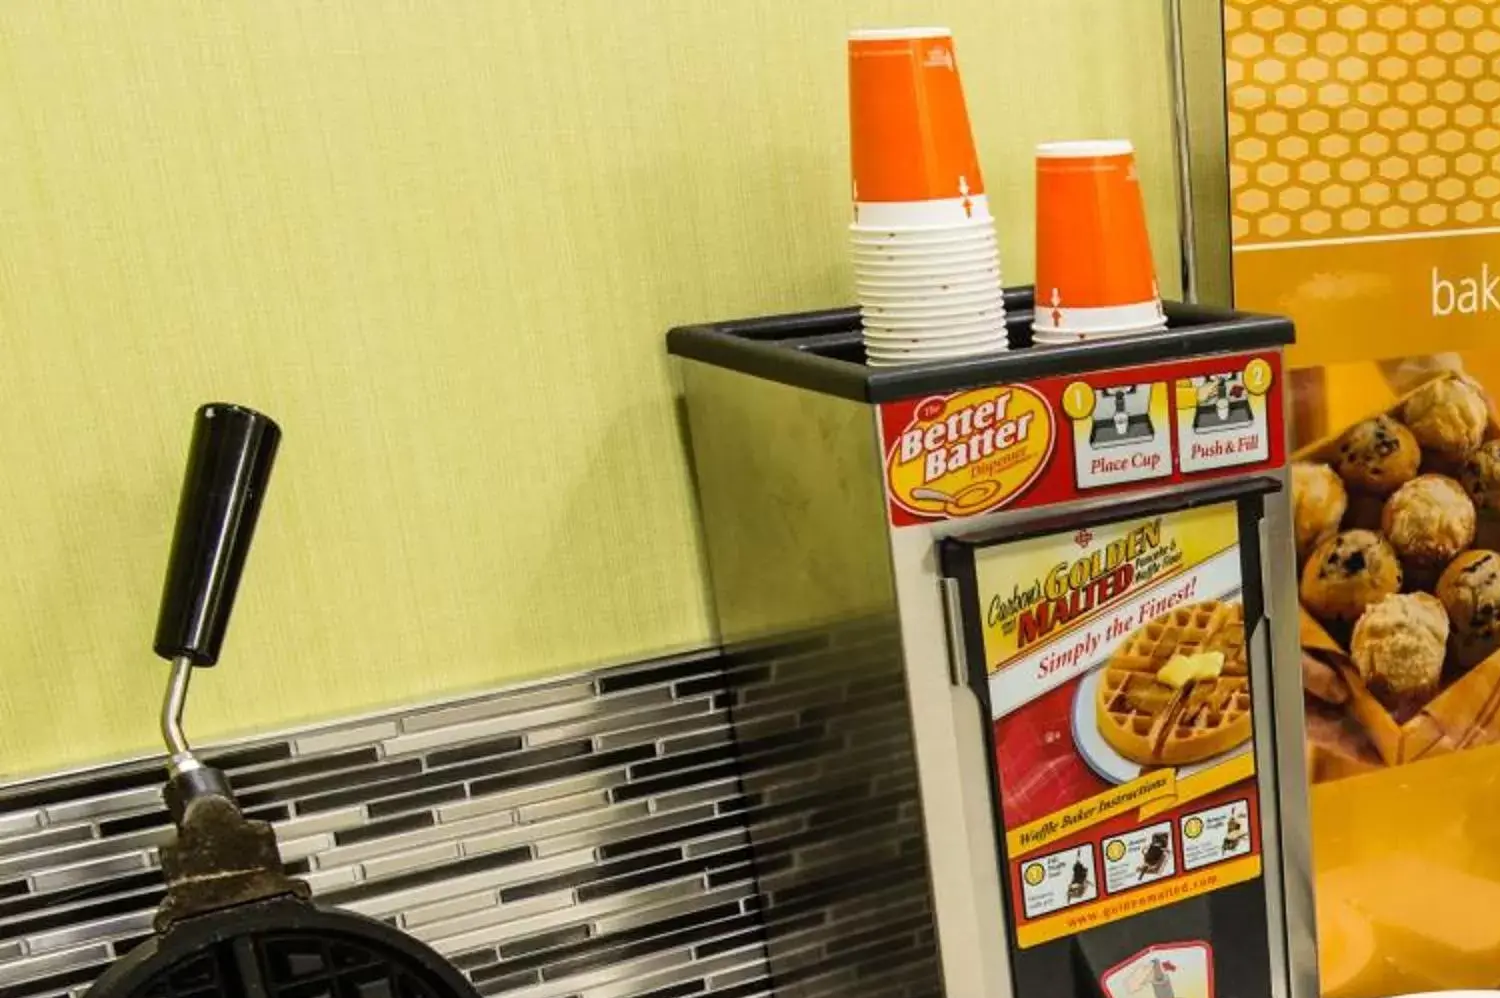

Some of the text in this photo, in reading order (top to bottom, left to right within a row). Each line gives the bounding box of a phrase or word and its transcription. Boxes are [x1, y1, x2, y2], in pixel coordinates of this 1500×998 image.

[899, 391, 1012, 465] Better
[923, 410, 1034, 484] Batter
[1090, 452, 1161, 475] Place Cup
[1191, 439, 1223, 460] Push
[1237, 434, 1260, 453] Fill
[1043, 517, 1163, 601] GOLDEN
[1016, 563, 1136, 649] MALTED
[1037, 575, 1198, 679] Simply the Finest!
[1060, 808, 1095, 829] Baker
[1098, 777, 1169, 814] Instructions
